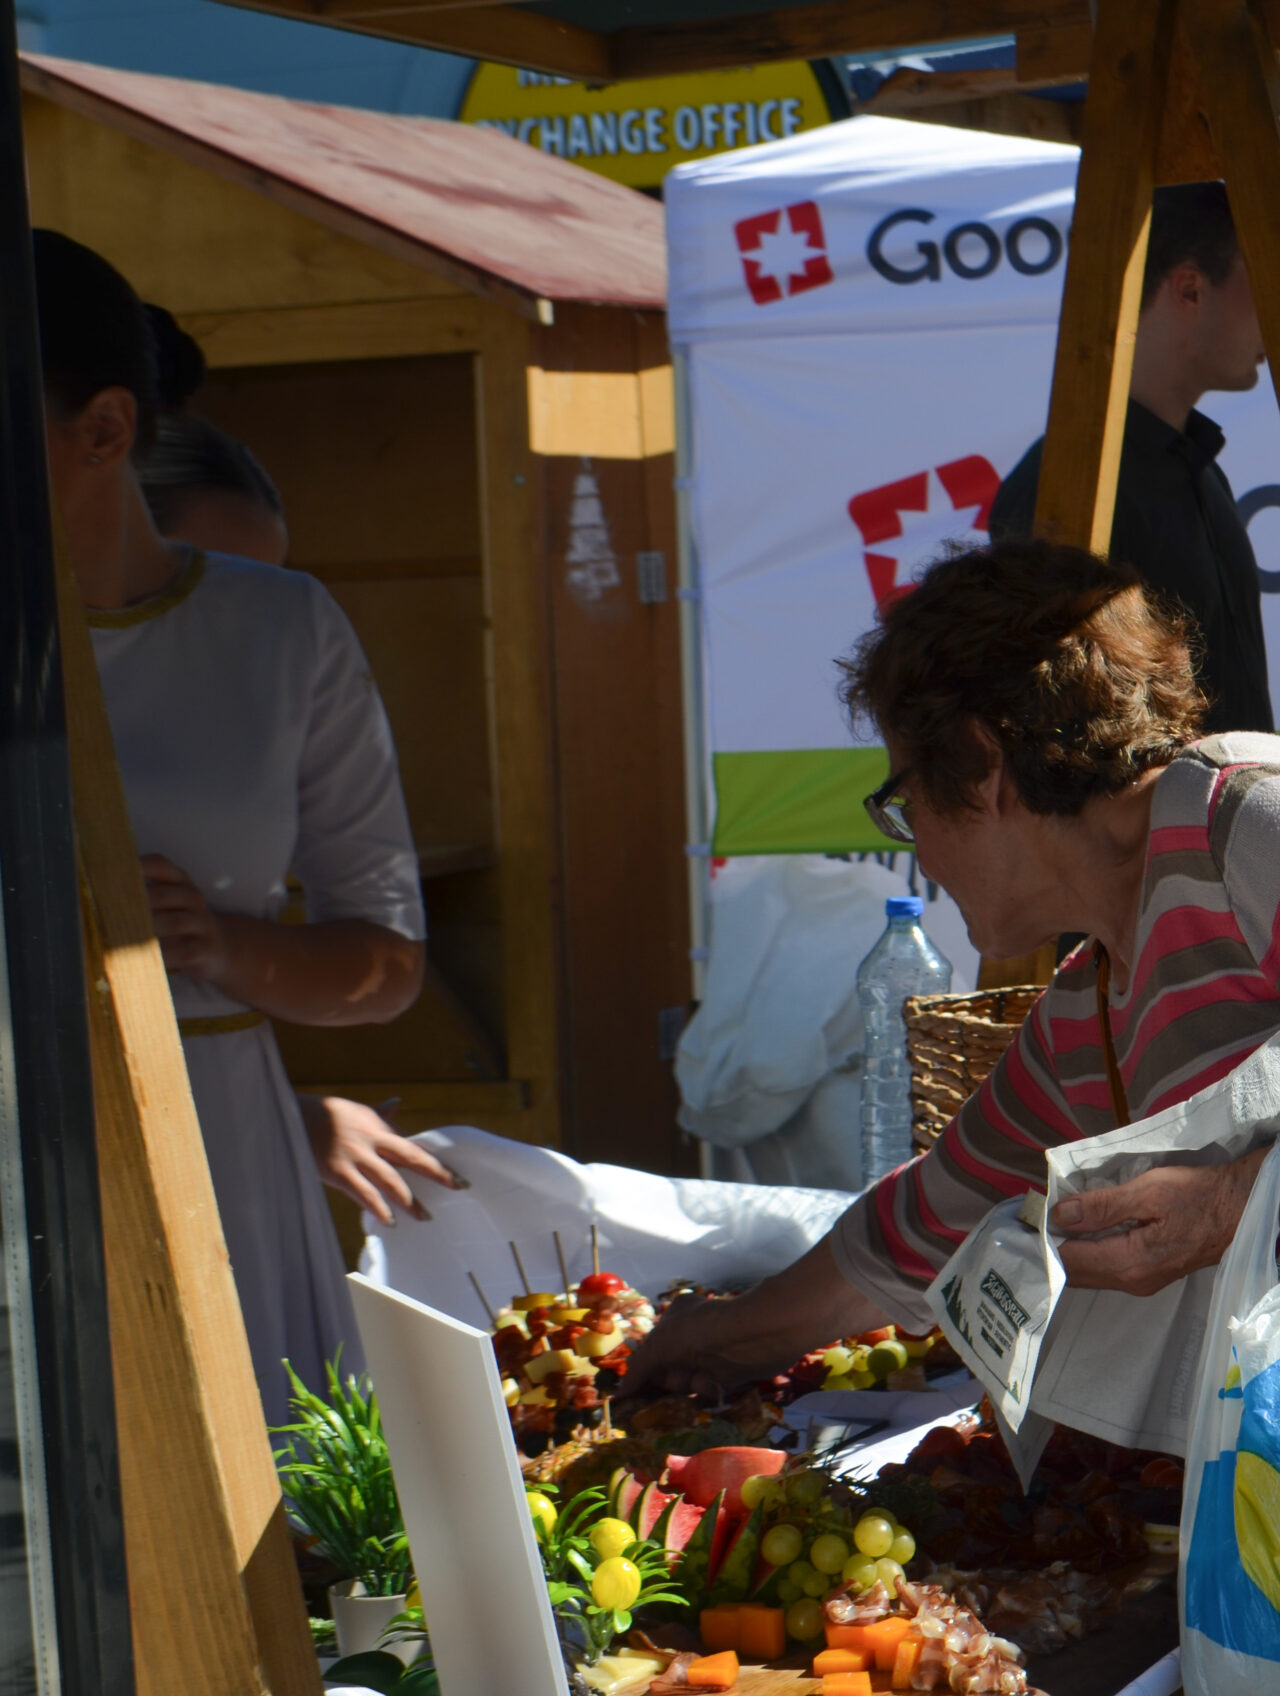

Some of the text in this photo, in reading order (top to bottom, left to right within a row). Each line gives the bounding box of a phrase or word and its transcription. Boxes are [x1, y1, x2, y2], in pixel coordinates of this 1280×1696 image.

[474, 97, 801, 158] CHANGE OFFICE
[866, 208, 1067, 286] Goo
